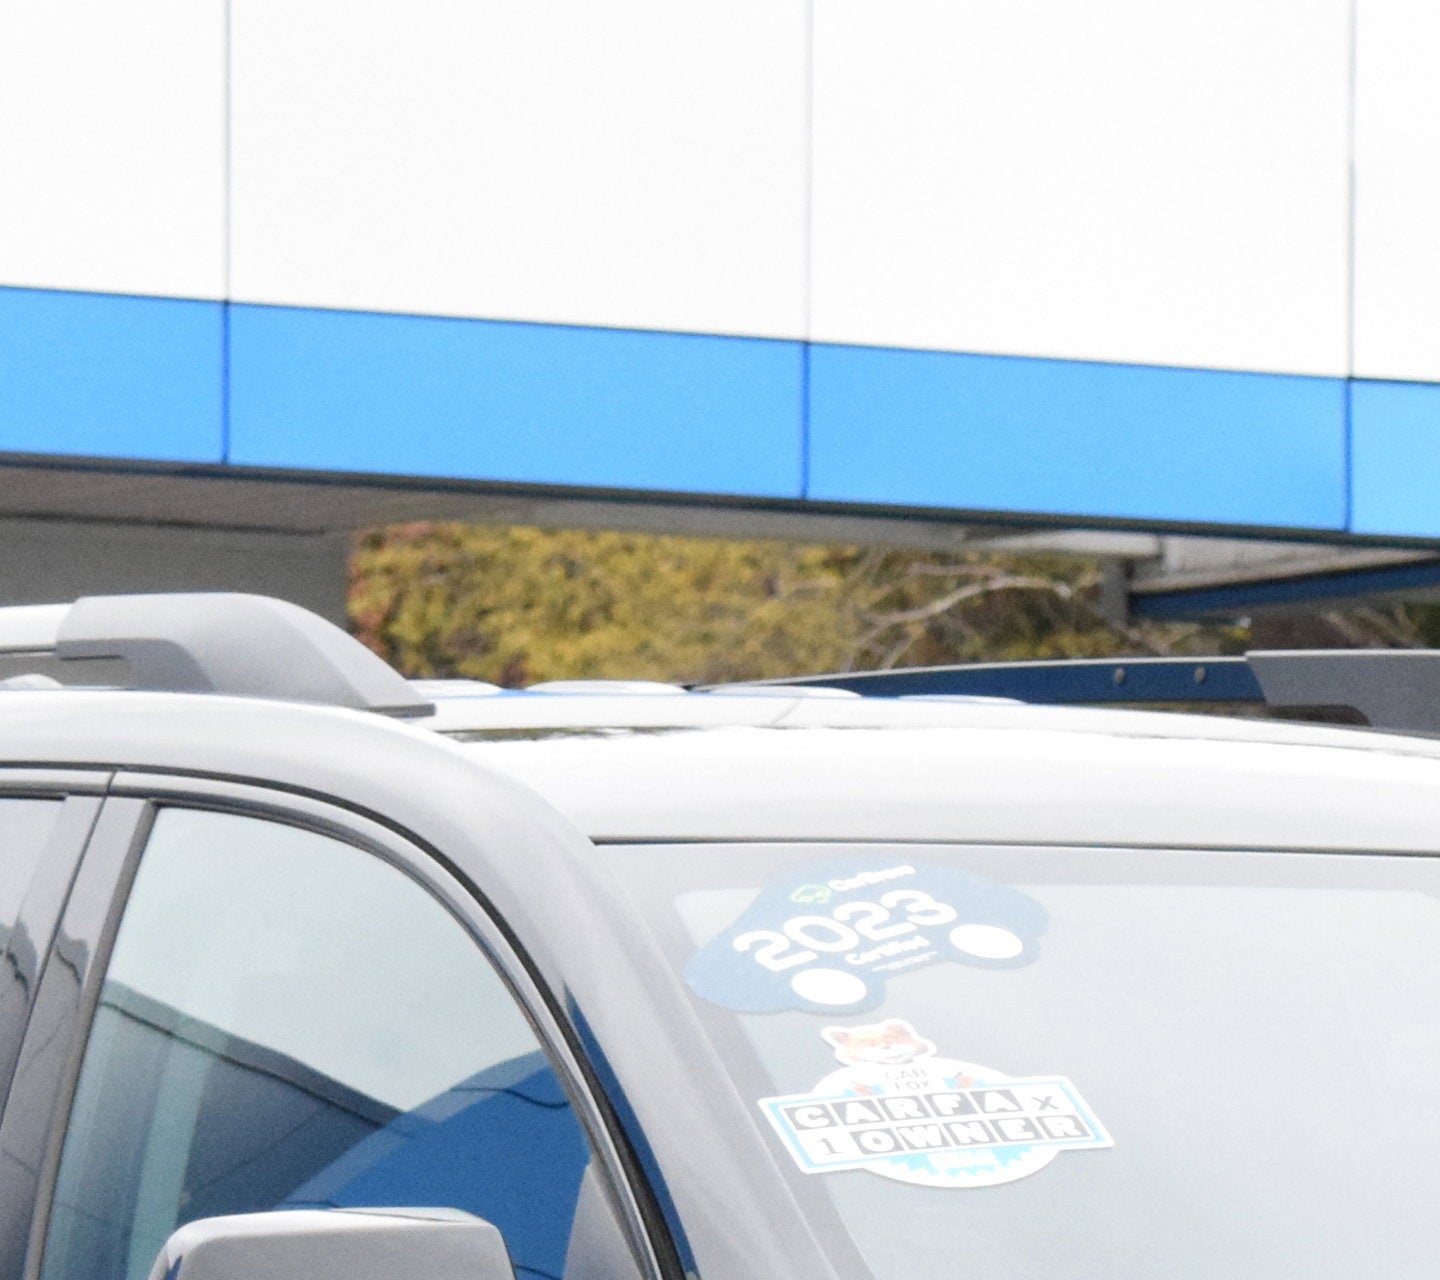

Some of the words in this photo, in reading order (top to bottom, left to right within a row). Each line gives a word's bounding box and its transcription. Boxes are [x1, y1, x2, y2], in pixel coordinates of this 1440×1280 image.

[731, 888, 958, 972] 2023
[788, 1088, 1060, 1131] CARFAX
[816, 1136, 838, 1155] 1
[851, 1114, 1088, 1155] OWNER
